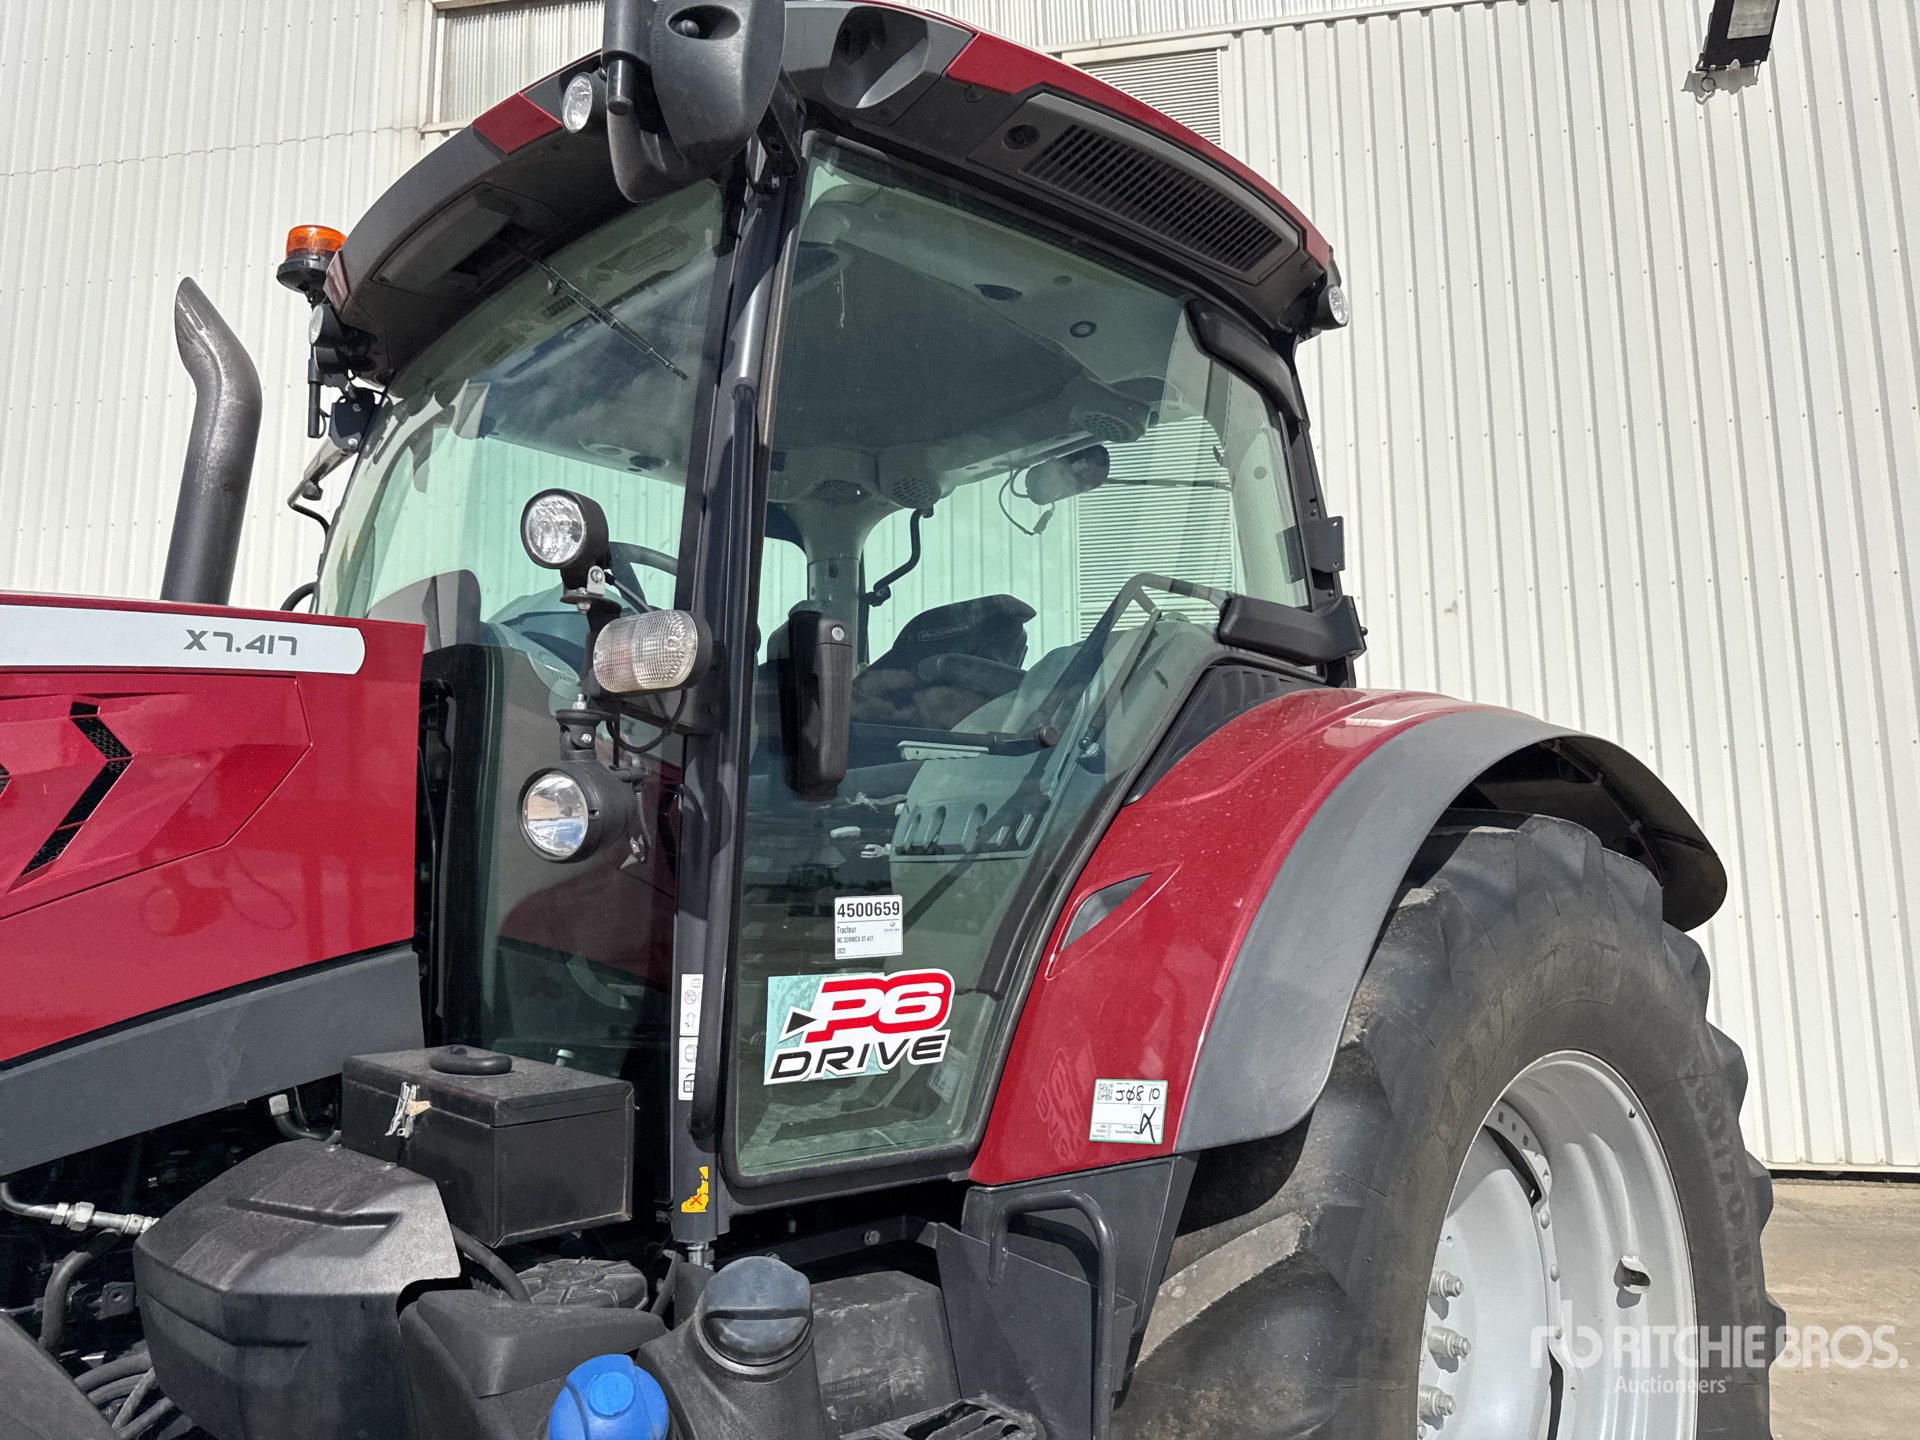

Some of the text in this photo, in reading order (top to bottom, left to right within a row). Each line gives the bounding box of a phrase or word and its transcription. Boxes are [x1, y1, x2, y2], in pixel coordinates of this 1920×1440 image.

[183, 629, 298, 656] X7.417
[837, 901, 900, 918] 4500659
[837, 926, 857, 934] Tracteur
[804, 972, 952, 1043] P6
[770, 1034, 946, 1079] DRIVE
